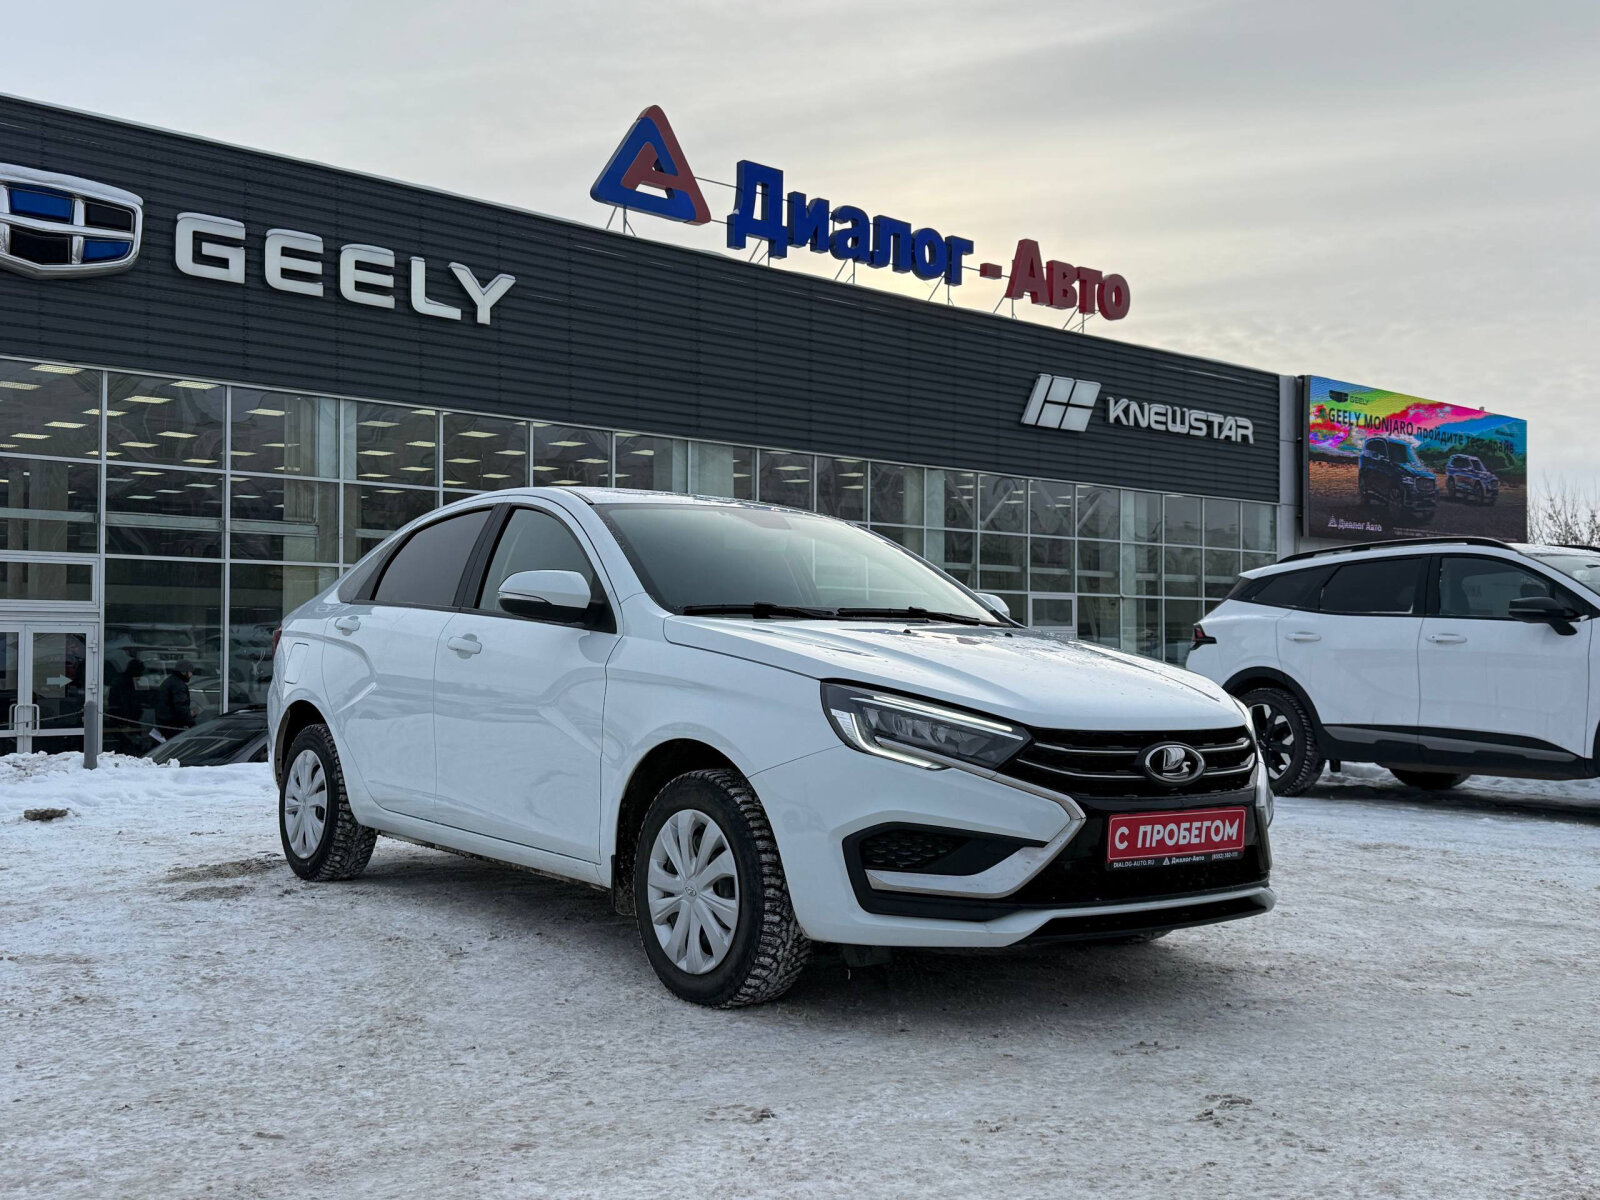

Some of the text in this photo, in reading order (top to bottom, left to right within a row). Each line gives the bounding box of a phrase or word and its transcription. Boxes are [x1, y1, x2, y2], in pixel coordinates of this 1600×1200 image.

[175, 212, 517, 326] GEELY
[1106, 396, 1254, 444] KNEWSTAR
[1328, 408, 1361, 427] GEELY
[1363, 413, 1414, 436] MONJARO
[1416, 426, 1464, 446] пройдите
[1338, 518, 1383, 532] Диалог Авто
[1114, 818, 1240, 850] С ПРОБЕГОМ
[1113, 859, 1155, 868] DIALOG-AUTO.RU
